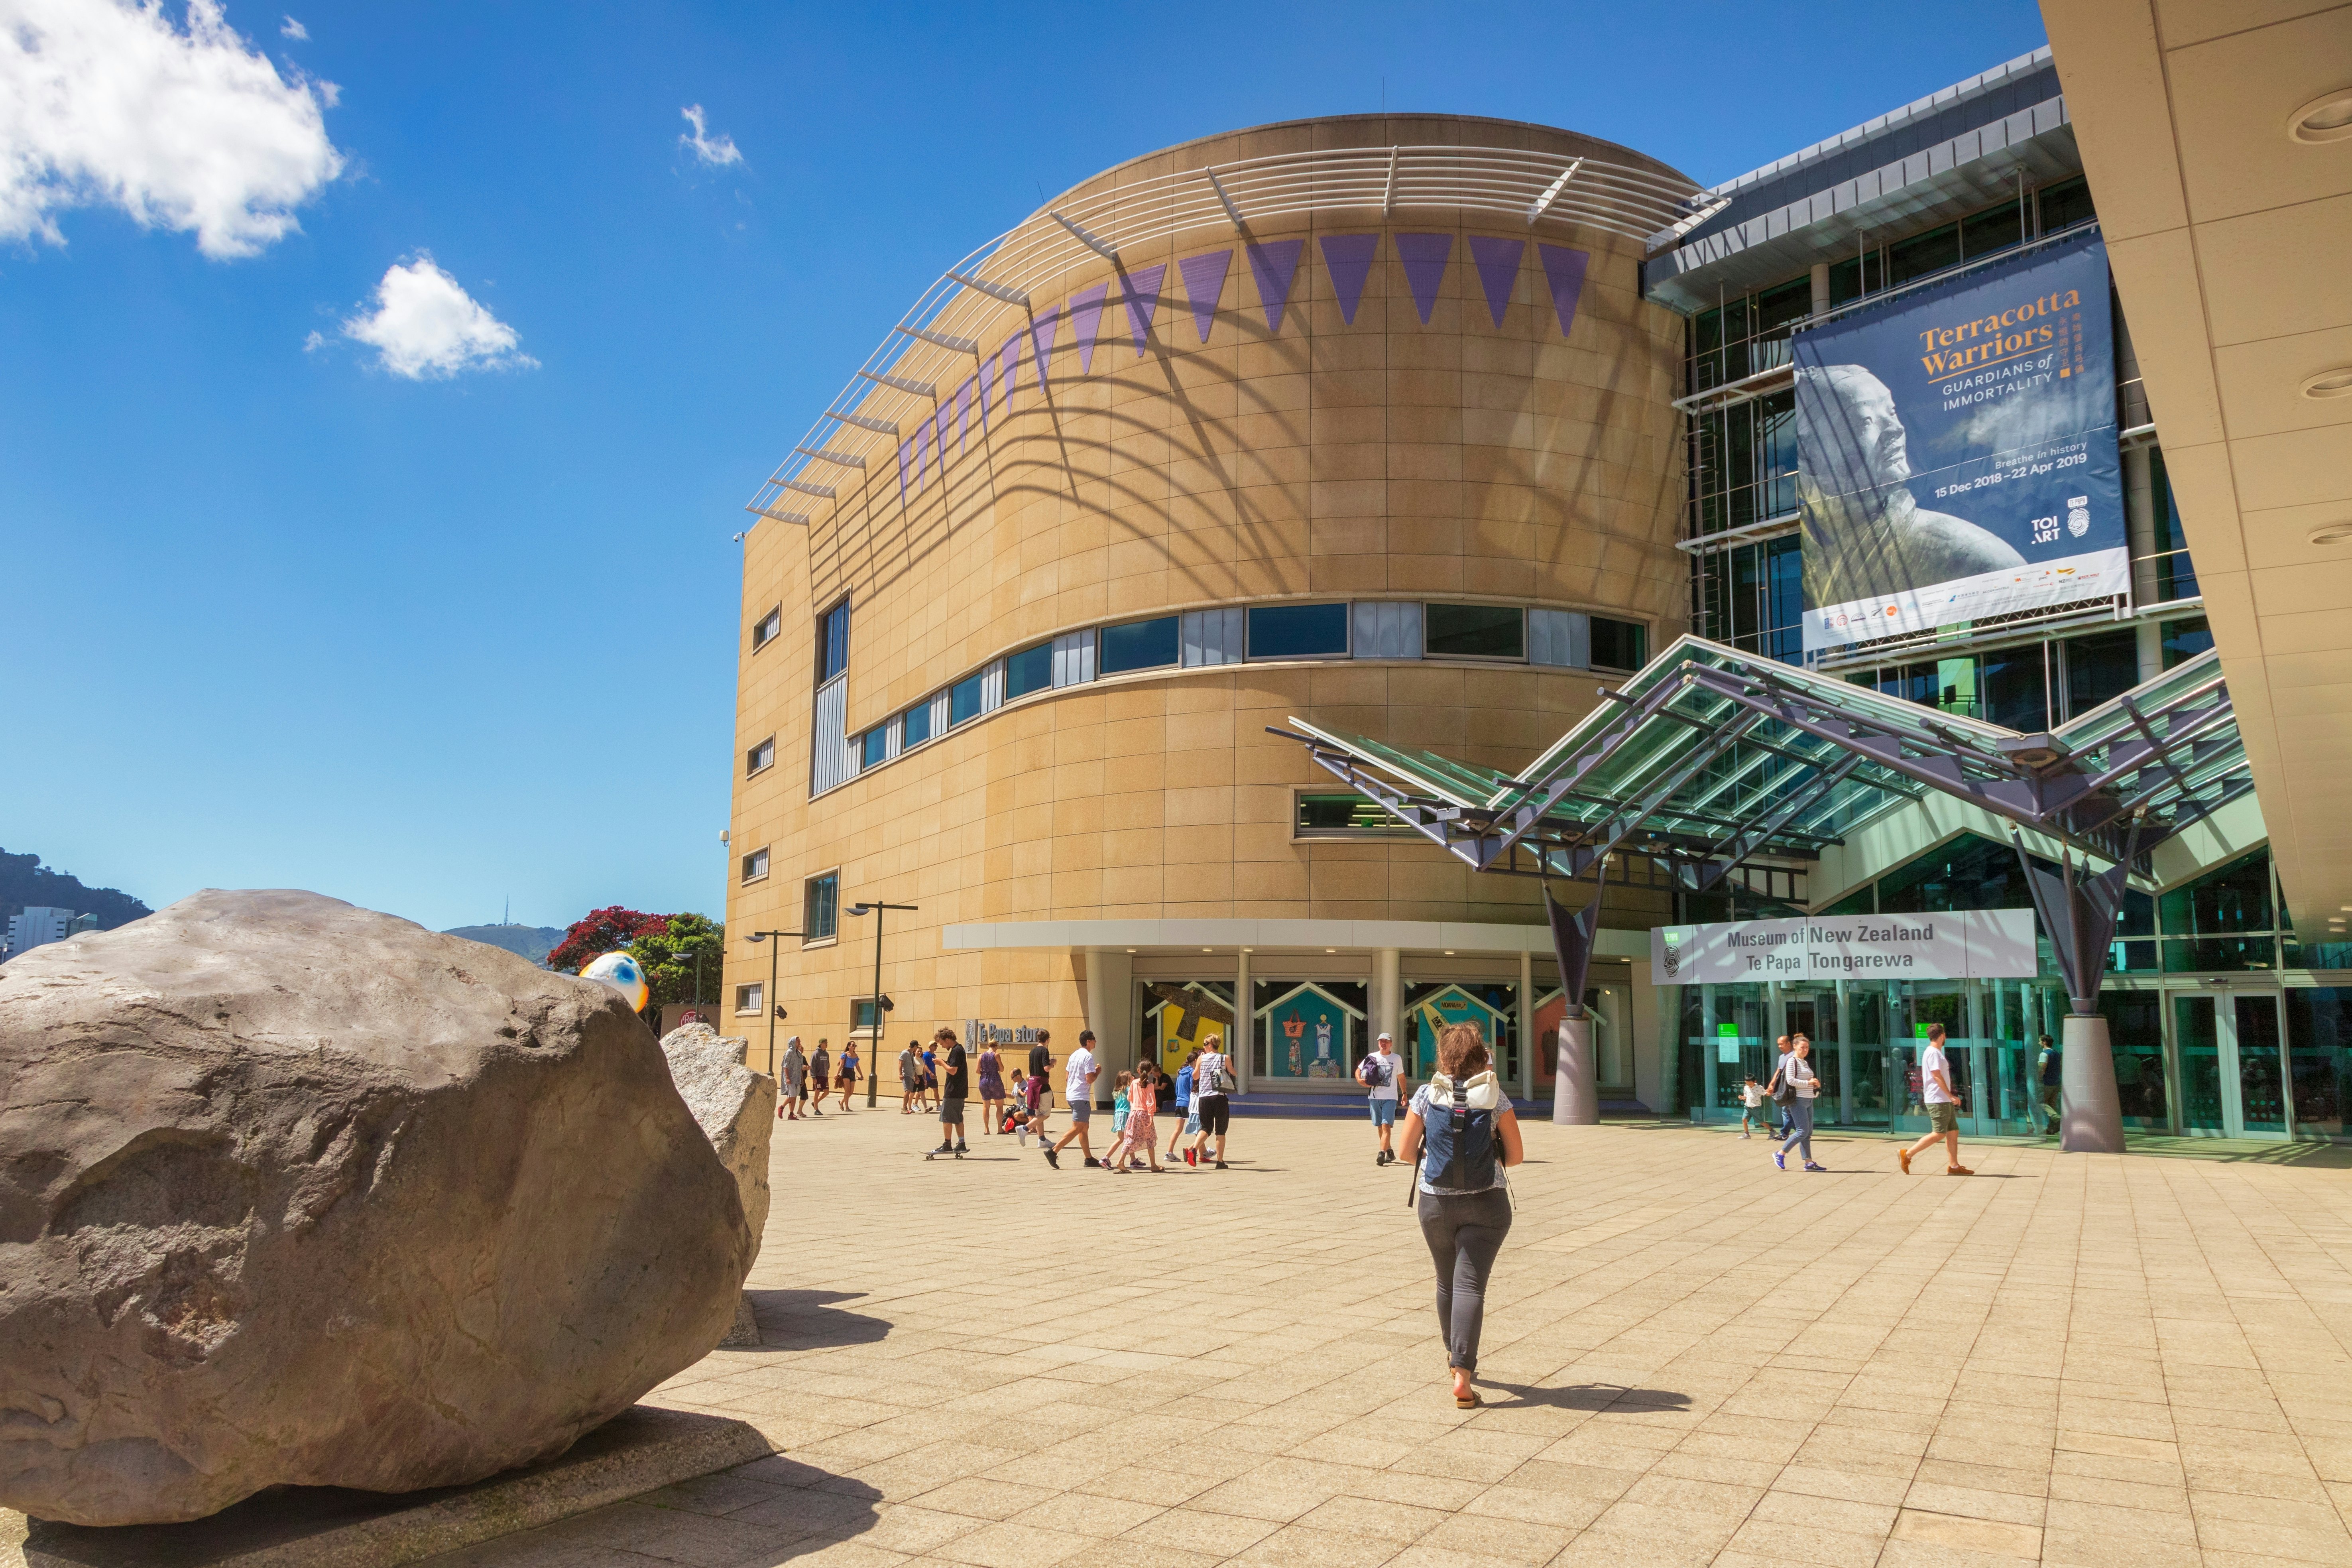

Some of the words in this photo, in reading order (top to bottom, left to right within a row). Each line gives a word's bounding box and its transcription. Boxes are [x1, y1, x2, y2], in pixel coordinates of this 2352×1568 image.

[1919, 289, 2081, 352] Terracotta
[1920, 324, 2053, 376] Warriors
[1943, 361, 2033, 395] GUARDIANS
[2038, 354, 2053, 369] of
[1944, 372, 2053, 411] IMMORTALITY
[1995, 454, 2033, 469] Breathe
[2037, 451, 2046, 459] in
[2050, 442, 2087, 456] history
[1935, 487, 1947, 498] 15
[1950, 482, 1972, 495] Dec
[2029, 462, 2053, 474] Apr
[2056, 453, 2087, 469] 2019
[2075, 497, 2085, 506] PAPA
[2031, 515, 2058, 531] TOI
[1669, 933, 1678, 941] PAPA
[1728, 932, 1787, 947] Museum
[1791, 928, 1805, 944] of
[1810, 927, 1852, 943] New
[1858, 923, 1933, 942] Zealand
[1746, 955, 1761, 970] Te
[1766, 954, 1801, 974] Papa
[1809, 952, 1913, 972] Tongarewa
[978, 1023, 987, 1042] Te
[989, 1023, 1013, 1046] Papa
[1015, 1025, 1046, 1042] stor
